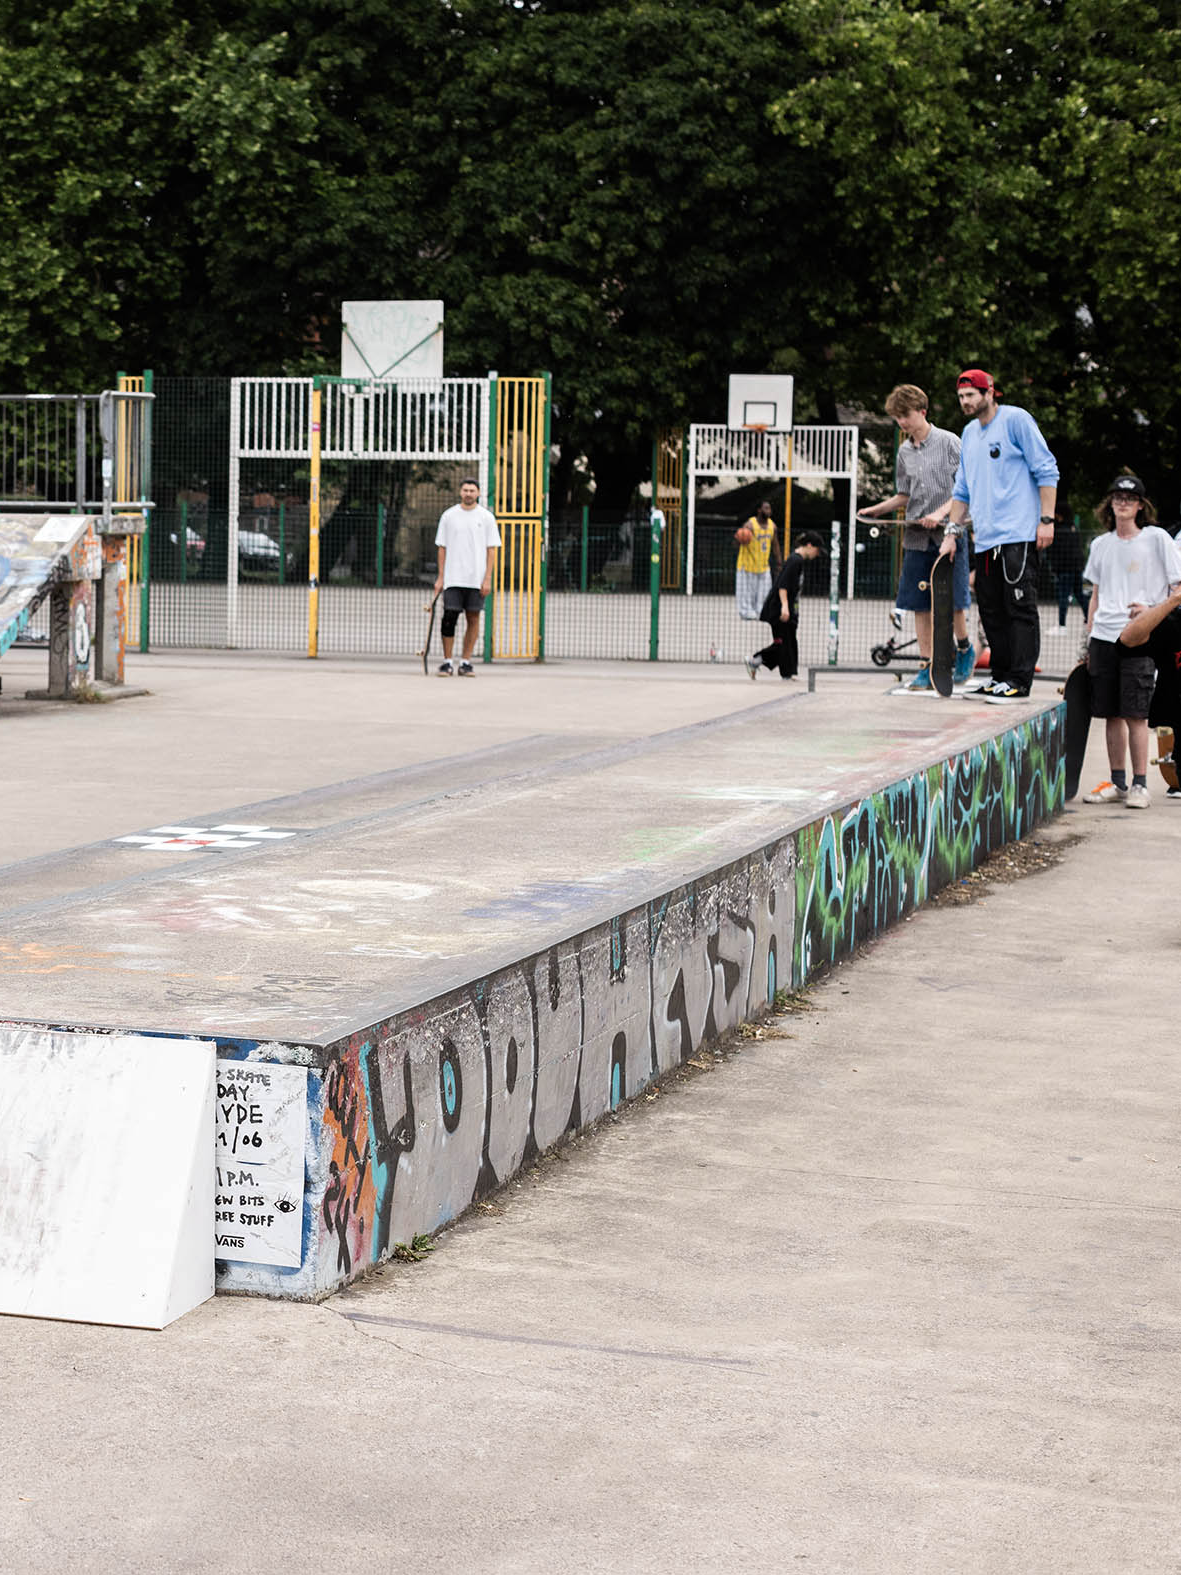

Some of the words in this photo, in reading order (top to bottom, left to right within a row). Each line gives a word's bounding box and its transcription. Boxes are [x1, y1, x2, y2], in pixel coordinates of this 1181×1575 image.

[226, 1069, 271, 1087] SKATE
[216, 1103, 263, 1125] YDE
[215, 1126, 263, 1154] 1/06
[239, 1195, 265, 1206] BITS
[239, 1213, 275, 1228] STUFF
[214, 1233, 245, 1248] VANS
